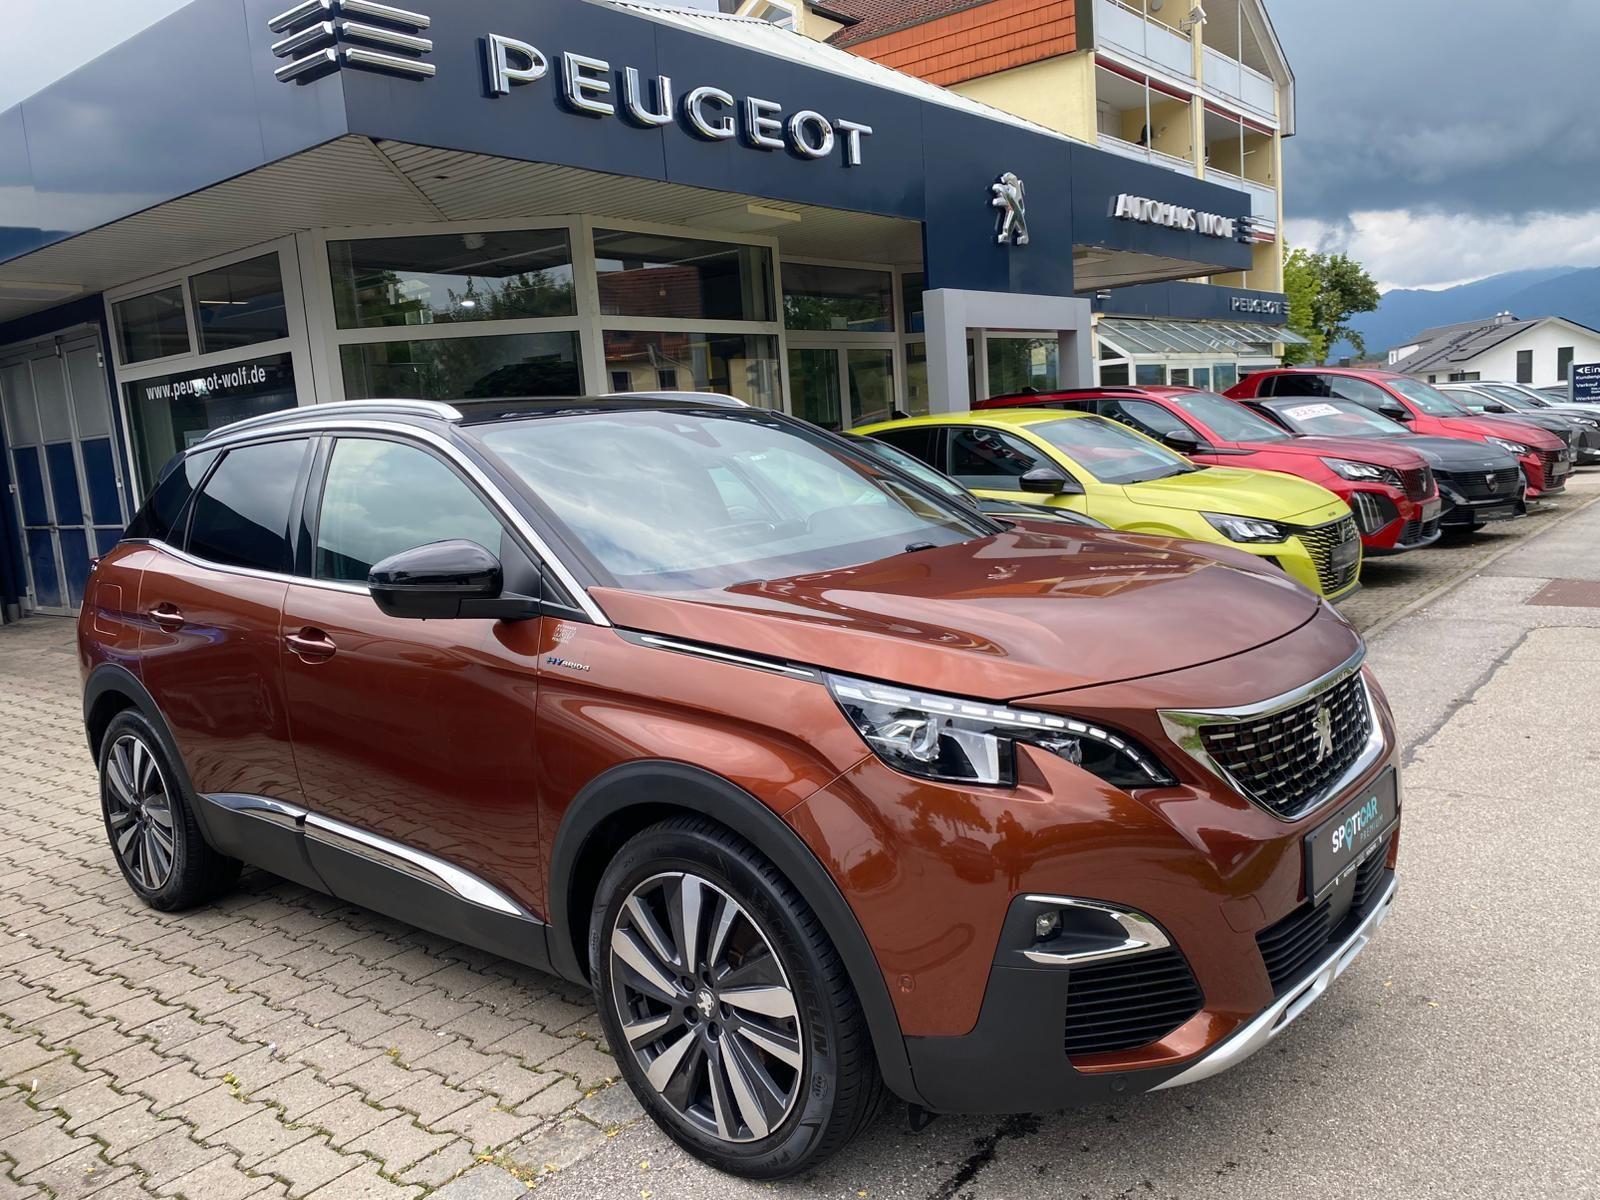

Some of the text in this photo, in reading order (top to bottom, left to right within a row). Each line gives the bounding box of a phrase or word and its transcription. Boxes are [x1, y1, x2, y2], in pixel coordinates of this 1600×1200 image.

[488, 33, 873, 166] PEUGEOT
[1114, 193, 1196, 231] AUTOHAUS
[1231, 297, 1280, 314] PEUGEOT
[146, 365, 266, 401] www.peugeot-wolf.de
